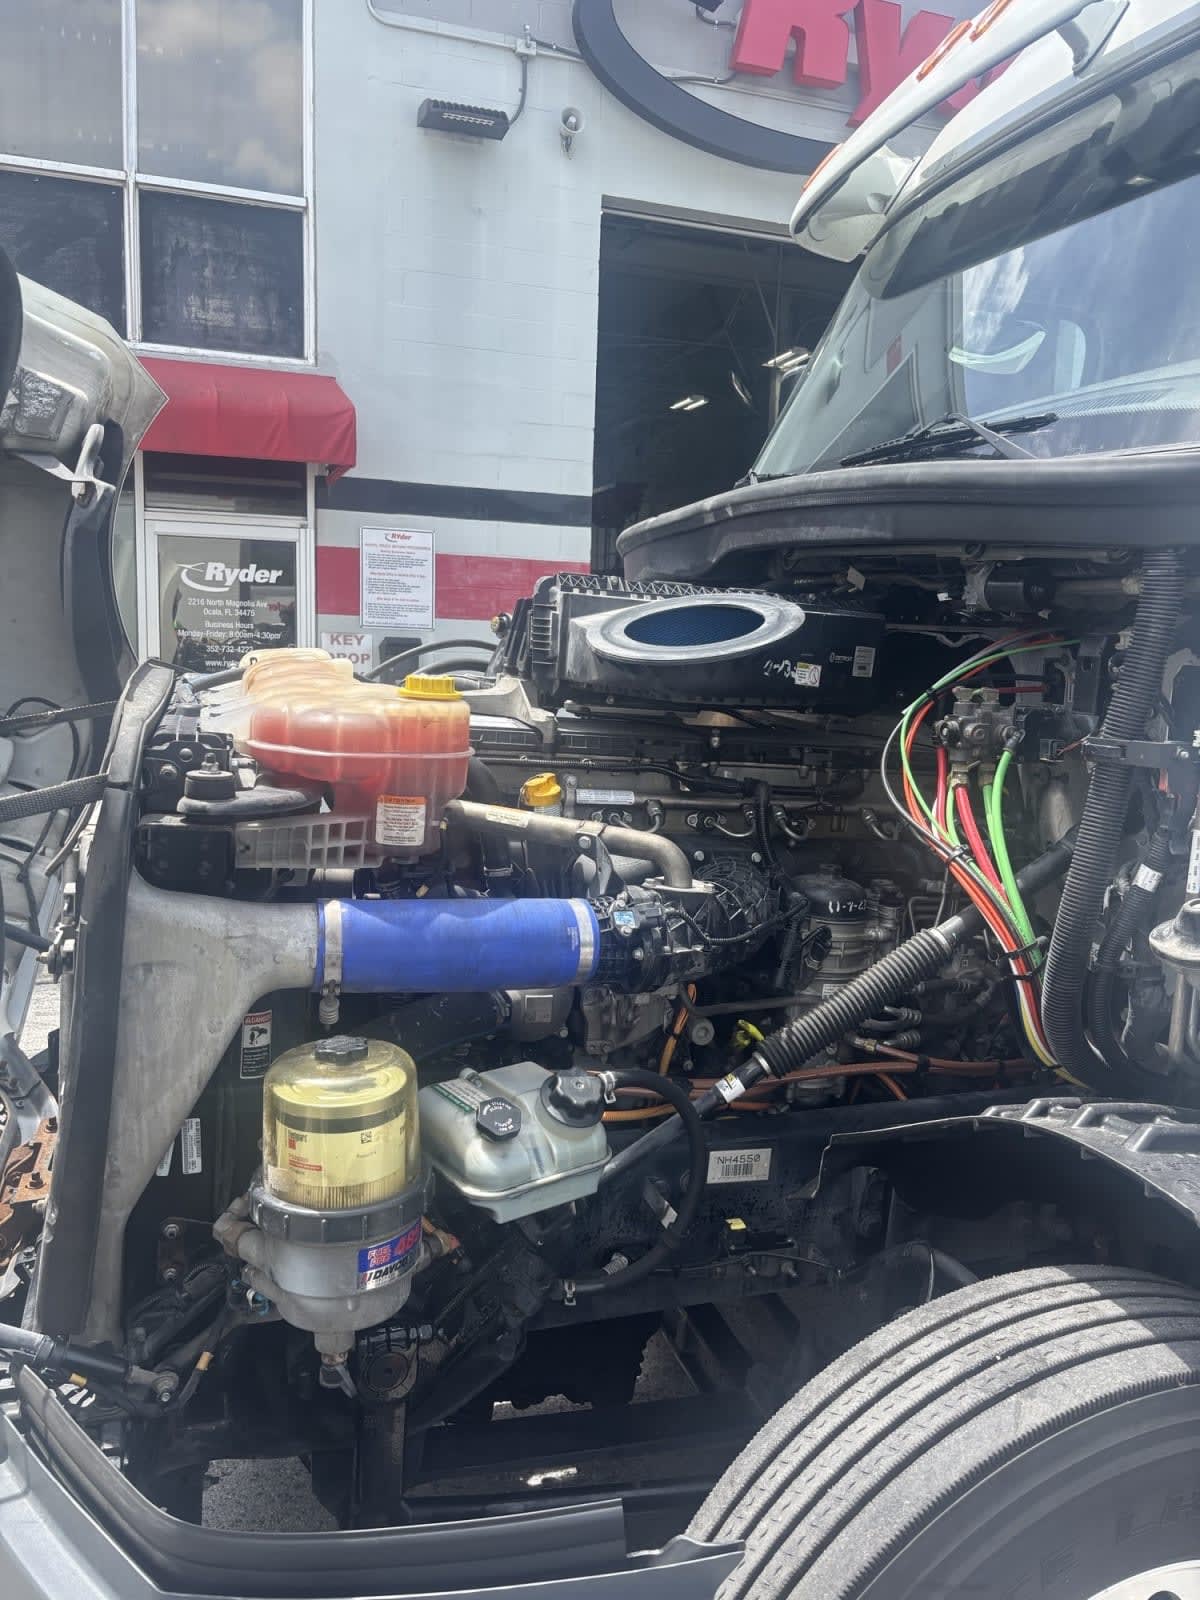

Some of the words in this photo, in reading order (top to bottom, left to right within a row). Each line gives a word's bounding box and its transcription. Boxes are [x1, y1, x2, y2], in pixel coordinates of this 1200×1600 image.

[204, 562, 283, 586] Ryder
[188, 598, 205, 606] 2216
[206, 598, 224, 606] North
[225, 599, 255, 608] Magnolia
[205, 621, 233, 629] Business
[330, 634, 365, 646] KEY
[716, 1154, 761, 1164] NH4550
